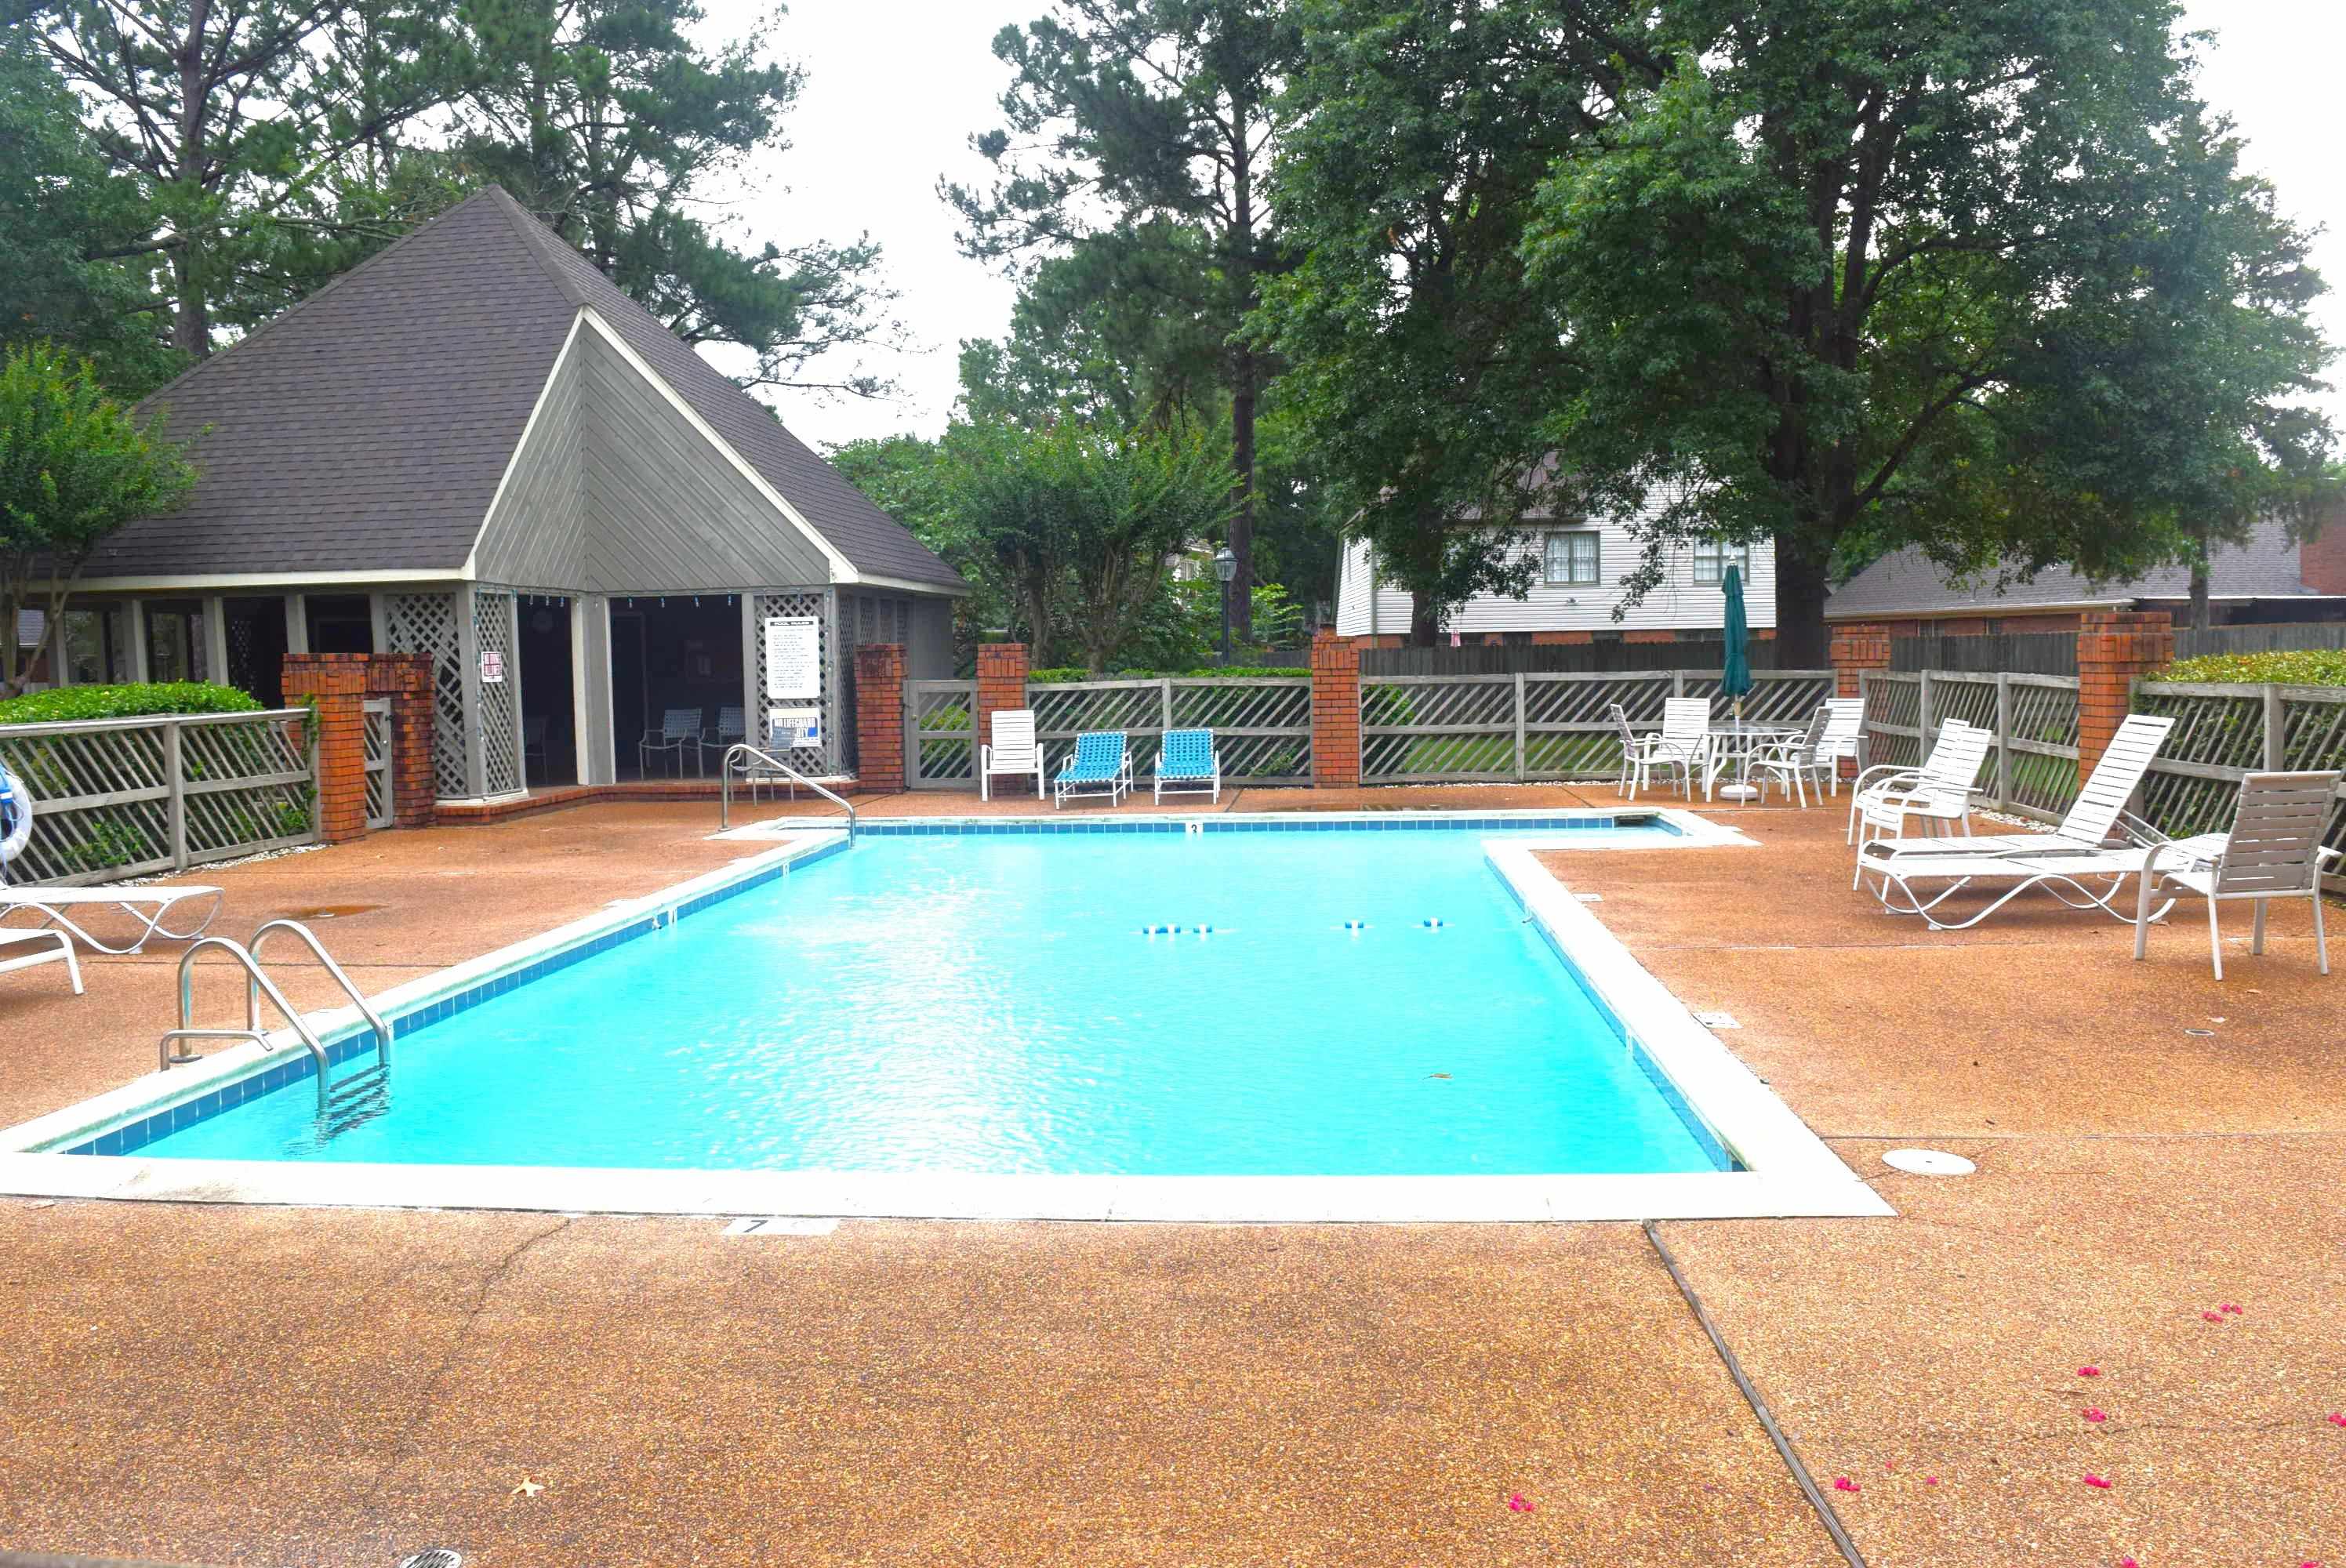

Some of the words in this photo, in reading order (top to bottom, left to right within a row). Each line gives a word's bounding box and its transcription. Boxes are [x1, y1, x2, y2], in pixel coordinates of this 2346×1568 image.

[774, 717, 783, 728] NO
[783, 717, 815, 728] LIFEGUARD
[742, 1220, 768, 1232] 7
